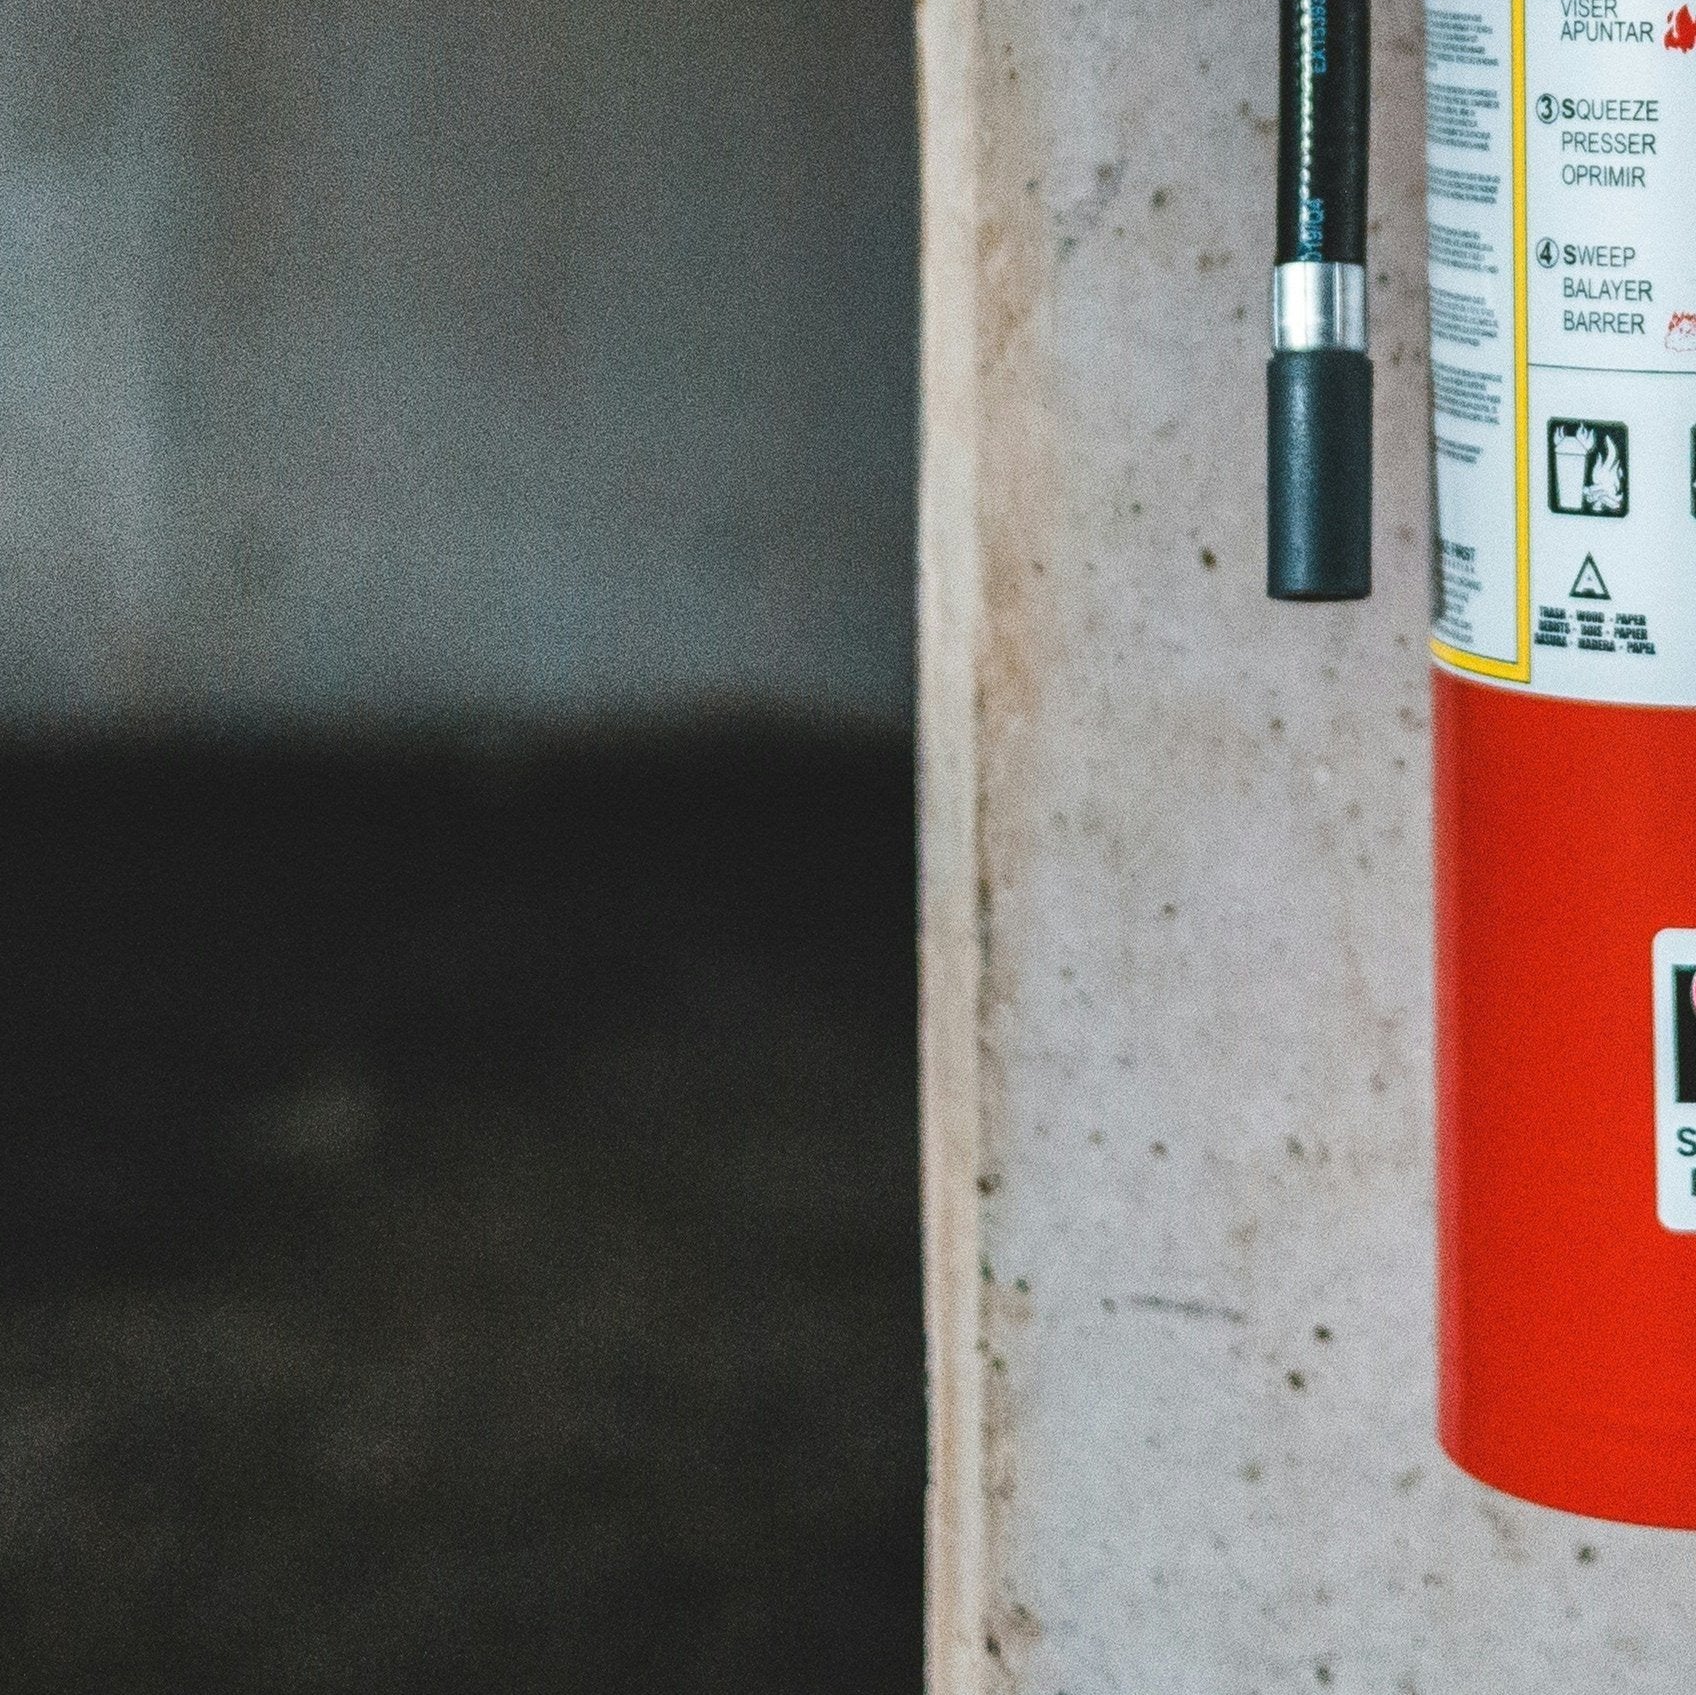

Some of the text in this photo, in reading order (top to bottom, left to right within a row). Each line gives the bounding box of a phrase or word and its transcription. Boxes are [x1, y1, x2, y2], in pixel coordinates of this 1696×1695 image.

[1560, 19, 1654, 43] APUNTAR
[1561, 98, 1659, 122] SQUEEZE
[1562, 130, 1656, 155] PRESSER
[1562, 164, 1646, 188] OPRIMIR
[1563, 244, 1636, 268] SWEEP
[1563, 277, 1653, 302] BALAYER
[1563, 309, 1645, 335] BARRER
